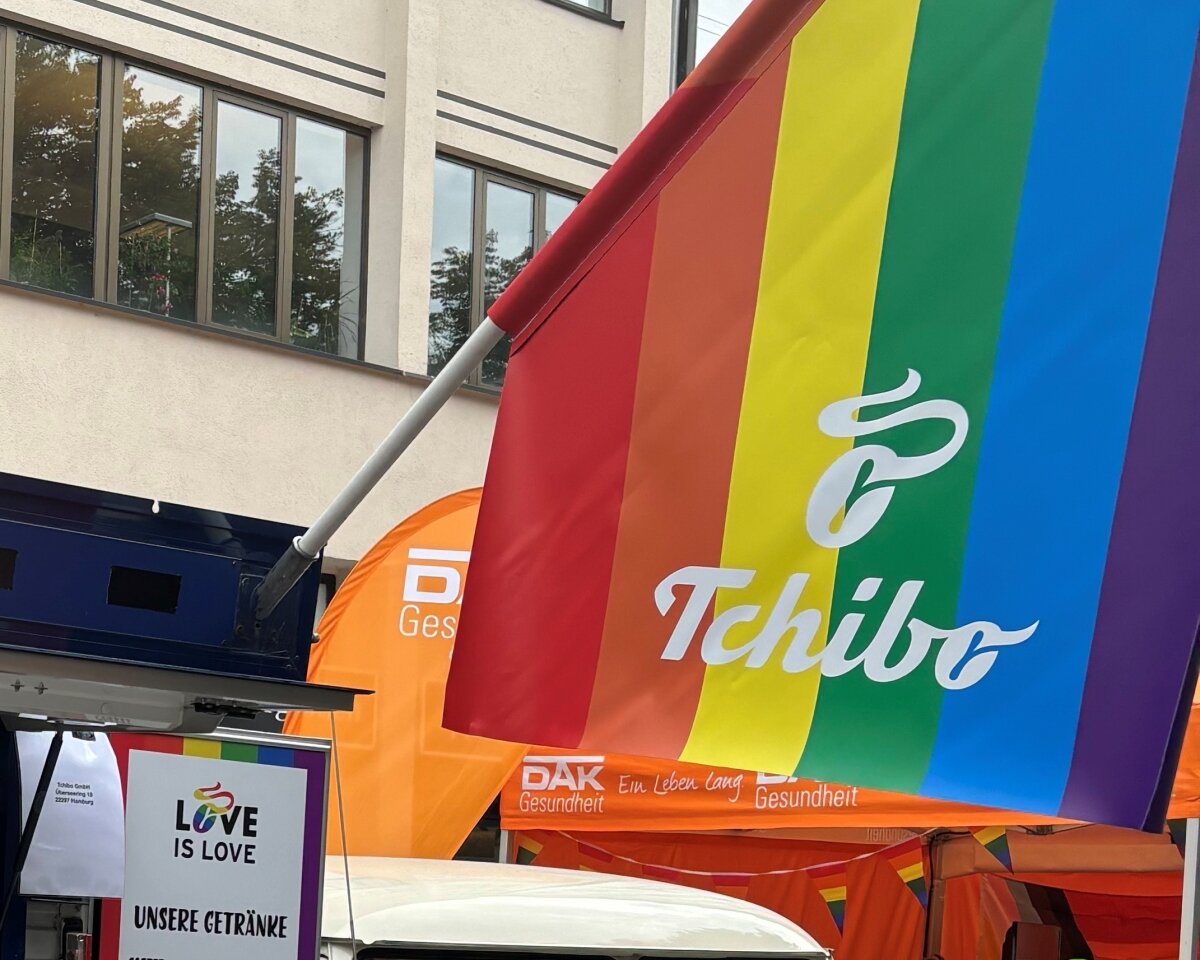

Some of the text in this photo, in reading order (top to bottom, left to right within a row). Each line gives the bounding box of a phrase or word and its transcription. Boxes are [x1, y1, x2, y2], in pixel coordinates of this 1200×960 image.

[653, 565, 1040, 690] Tchibo
[521, 755, 605, 792] DAK
[619, 775, 647, 794] Ein
[654, 771, 698, 795] Leben
[176, 782, 258, 837] LOVE
[519, 792, 604, 813] Gesundheit
[755, 784, 858, 810] Gesundheit
[174, 838, 256, 864] IS LOVE
[135, 905, 288, 938] UNSERE GETRÄNKE
